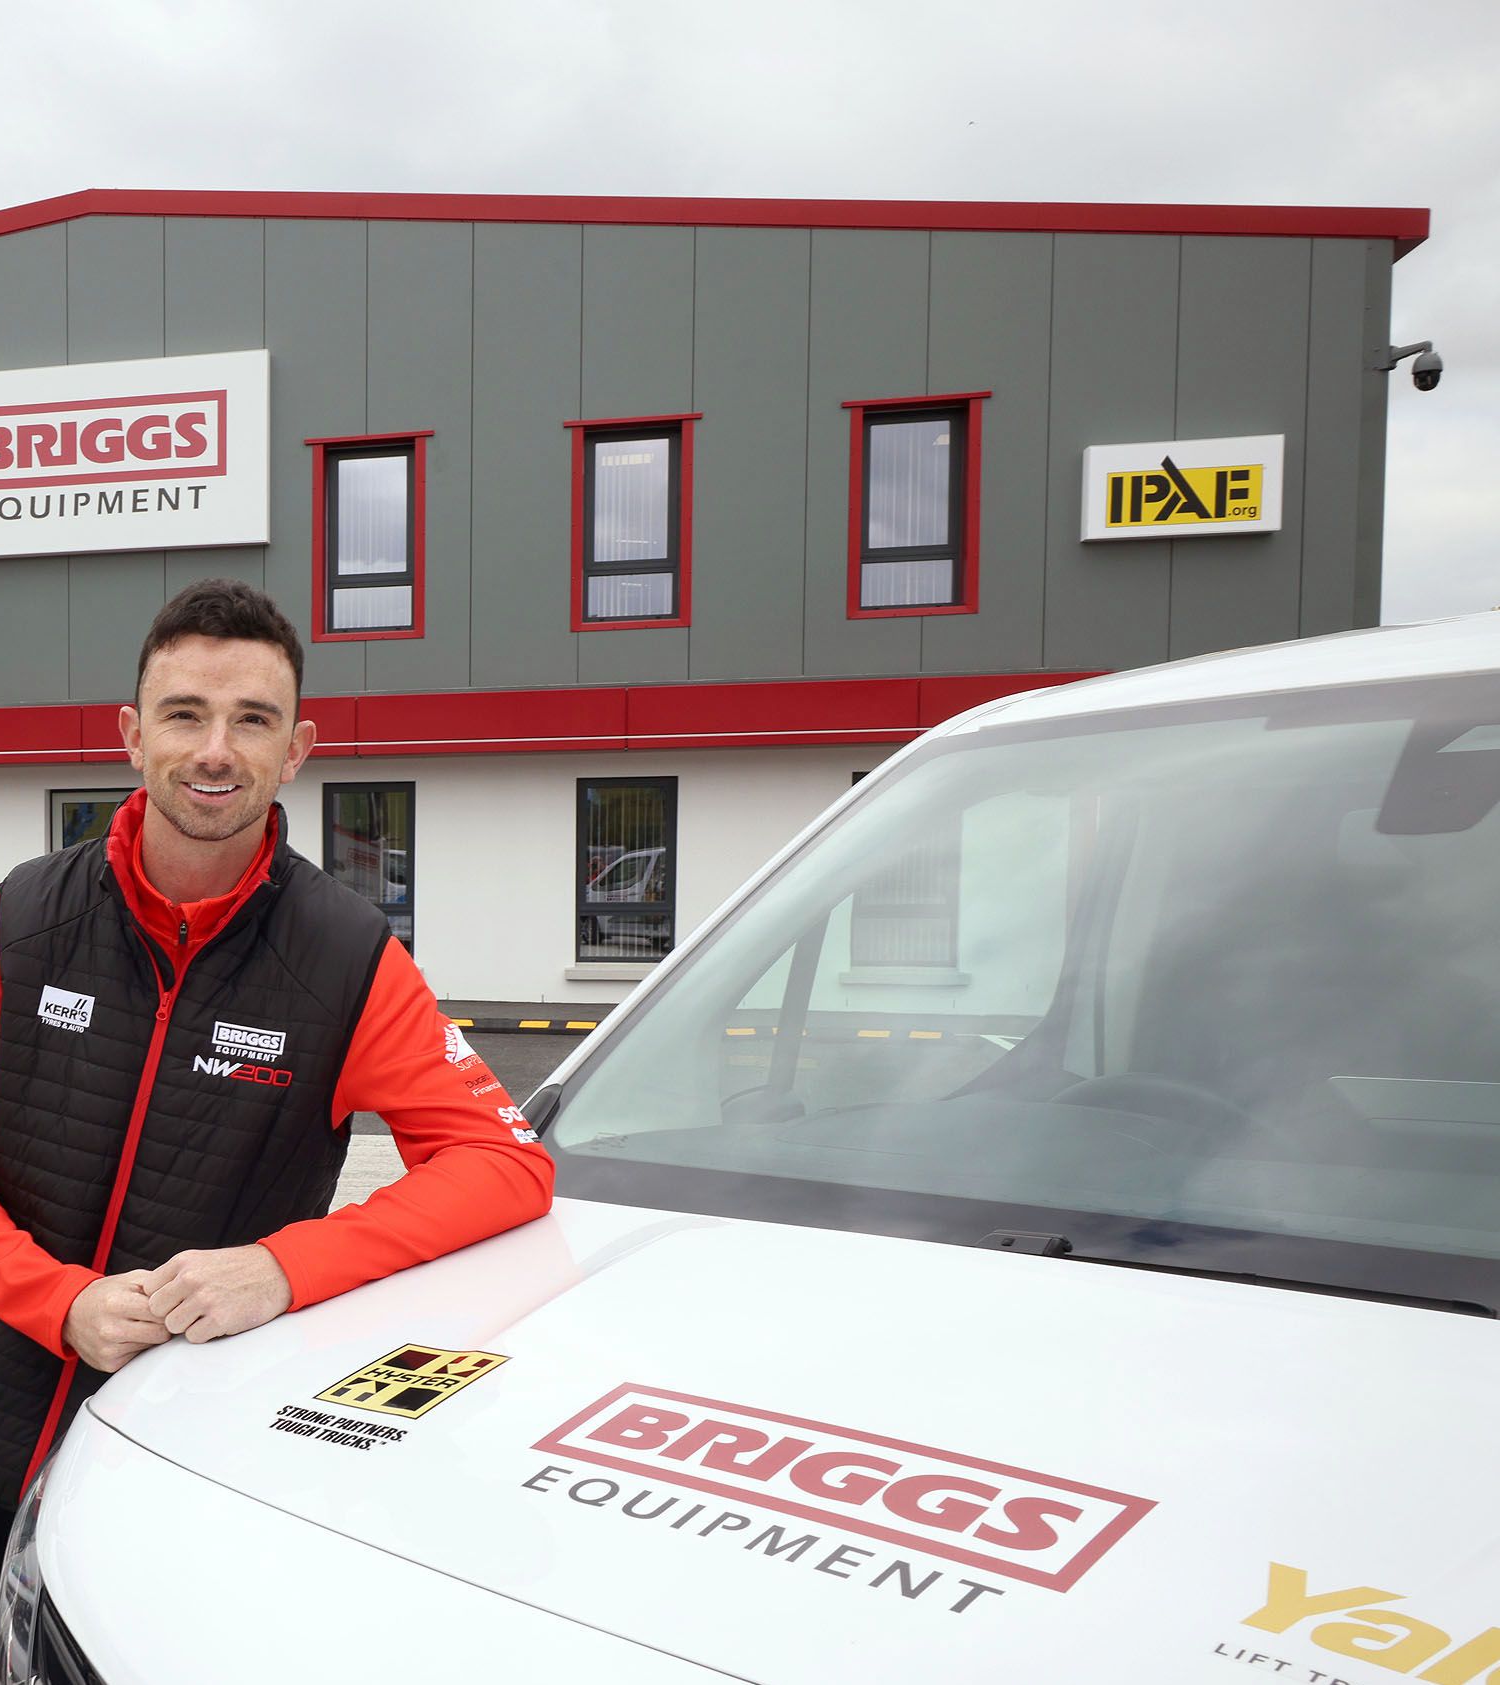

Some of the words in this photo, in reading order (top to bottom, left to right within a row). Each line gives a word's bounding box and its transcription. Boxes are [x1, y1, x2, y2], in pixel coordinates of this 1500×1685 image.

[1110, 455, 1250, 523] IPAF
[43, 1002, 88, 1022] KERR'S
[217, 1027, 281, 1050] BRIGGS
[215, 1045, 278, 1062] EQUIPMENT
[364, 1368, 461, 1389] HYSTER
[268, 1418, 320, 1437] TOUGH
[276, 1405, 337, 1426] STRONG
[332, 1416, 408, 1442] PARTNERS.
[585, 1403, 1085, 1551] BRIGGS
[521, 1465, 1006, 1613] EQUIPMENT
[1239, 1561, 1500, 1685] Yal
[1214, 1643, 1292, 1672] LIFT
